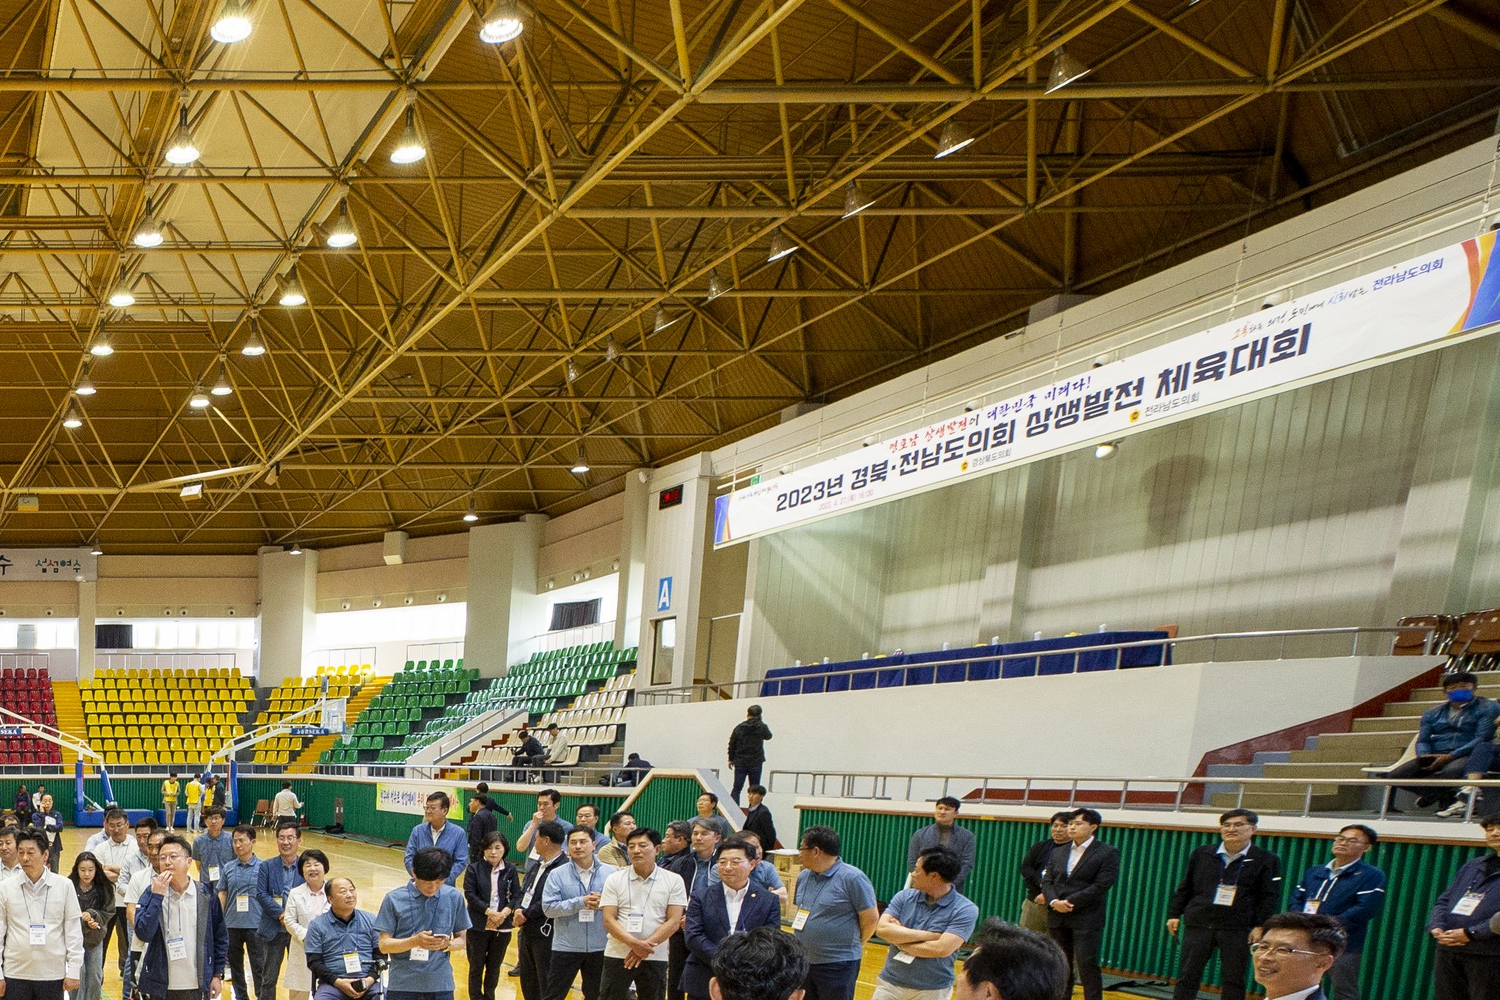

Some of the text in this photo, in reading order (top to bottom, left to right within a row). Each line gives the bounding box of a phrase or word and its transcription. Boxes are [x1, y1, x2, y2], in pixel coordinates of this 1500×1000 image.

[1372, 257, 1445, 292] 전라남도의회
[776, 322, 1313, 512] 2023년 경북·전남도의회 상생발전 체육대회
[888, 376, 1092, 454] 영호남 상생발전이 대한민국 미래다!
[1144, 391, 1200, 418] 전라남도의회
[972, 448, 1012, 469] 경상북도의회
[658, 580, 670, 609] A
